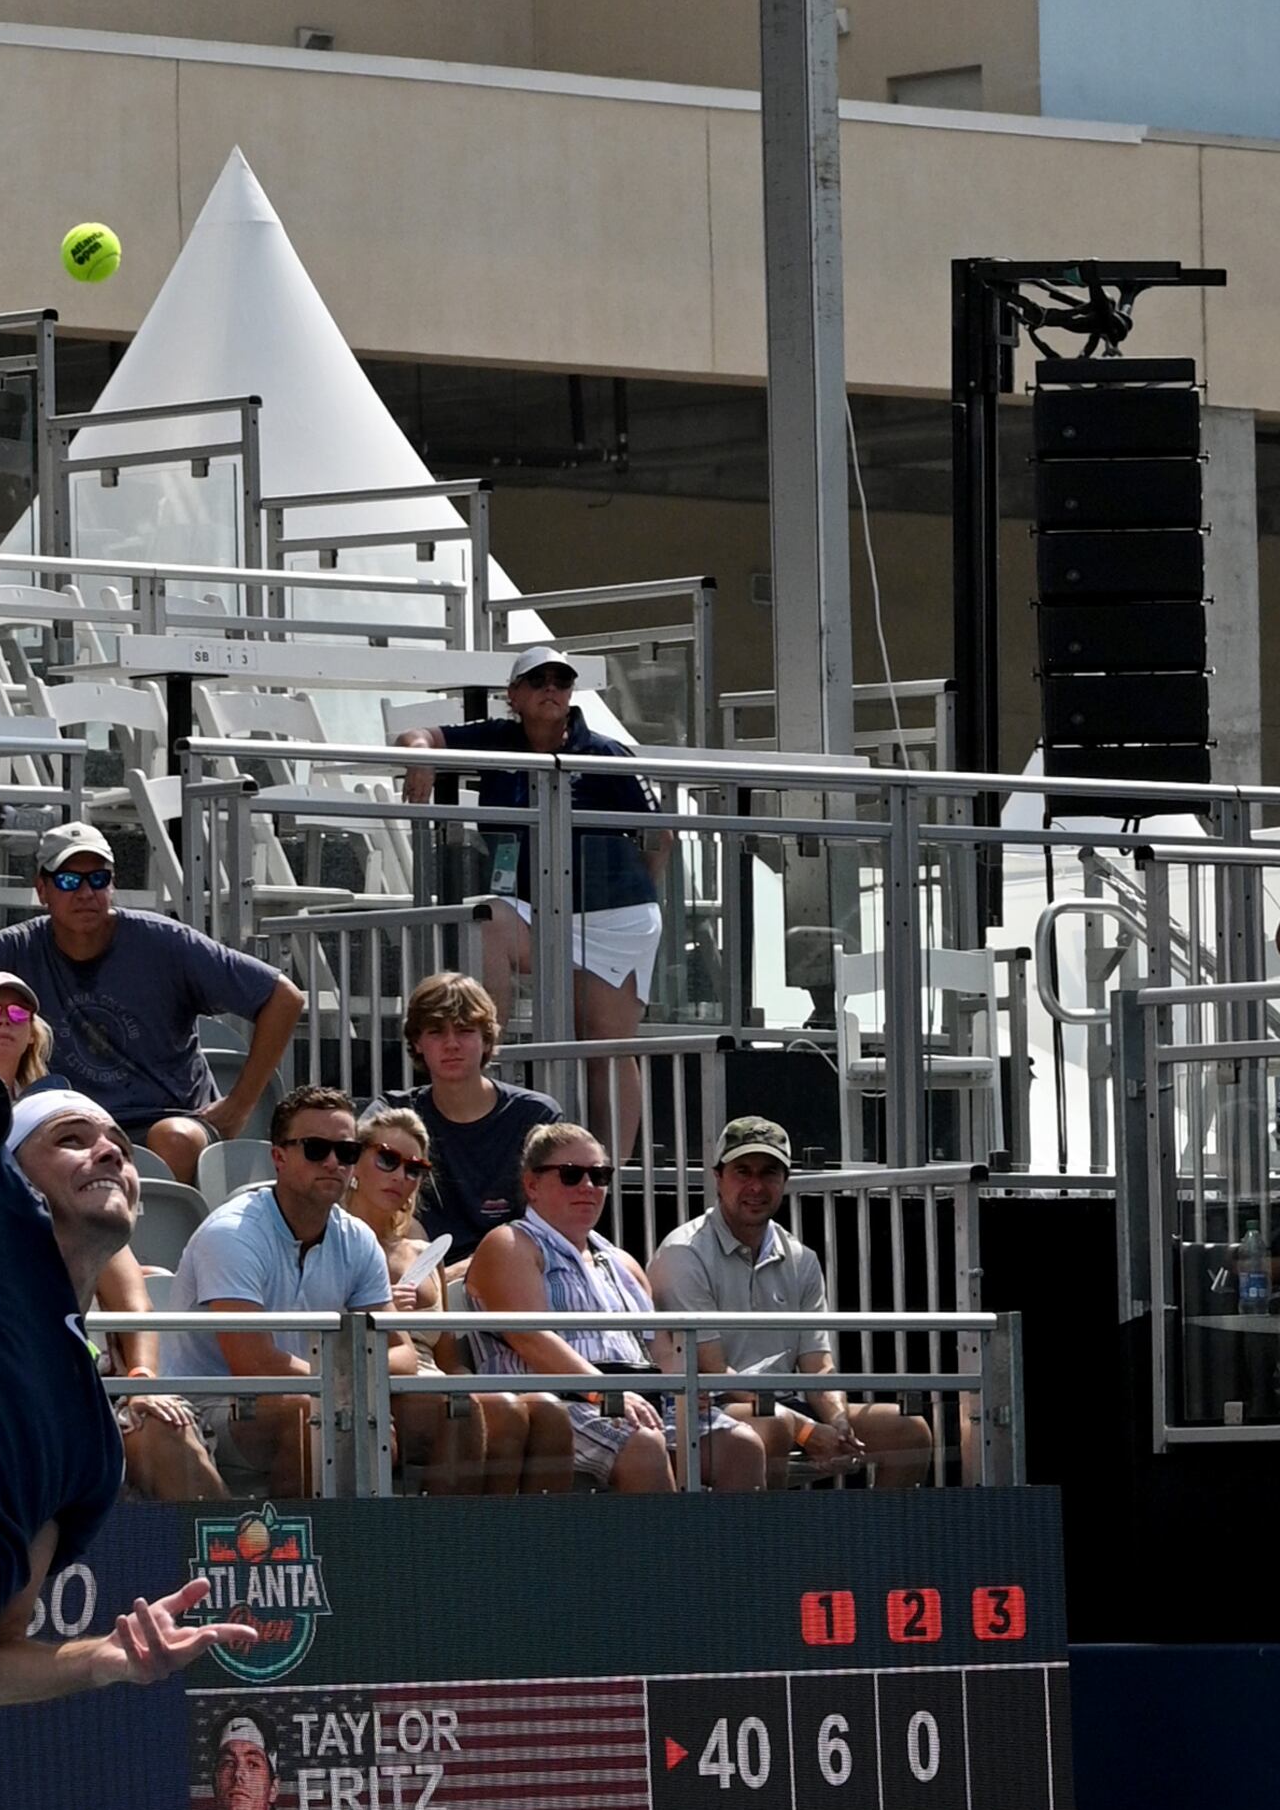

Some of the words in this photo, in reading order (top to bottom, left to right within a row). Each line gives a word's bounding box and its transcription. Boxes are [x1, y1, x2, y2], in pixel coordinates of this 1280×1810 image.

[194, 651, 210, 662] SB
[194, 1564, 322, 1609] ATLANTA
[816, 1597, 842, 1637] 1
[902, 1593, 929, 1635] 2
[986, 1590, 1012, 1634] 3
[292, 1710, 460, 1758] TAYLOR
[697, 1714, 773, 1789] 40
[817, 1714, 852, 1785] 6
[906, 1710, 941, 1782] 0
